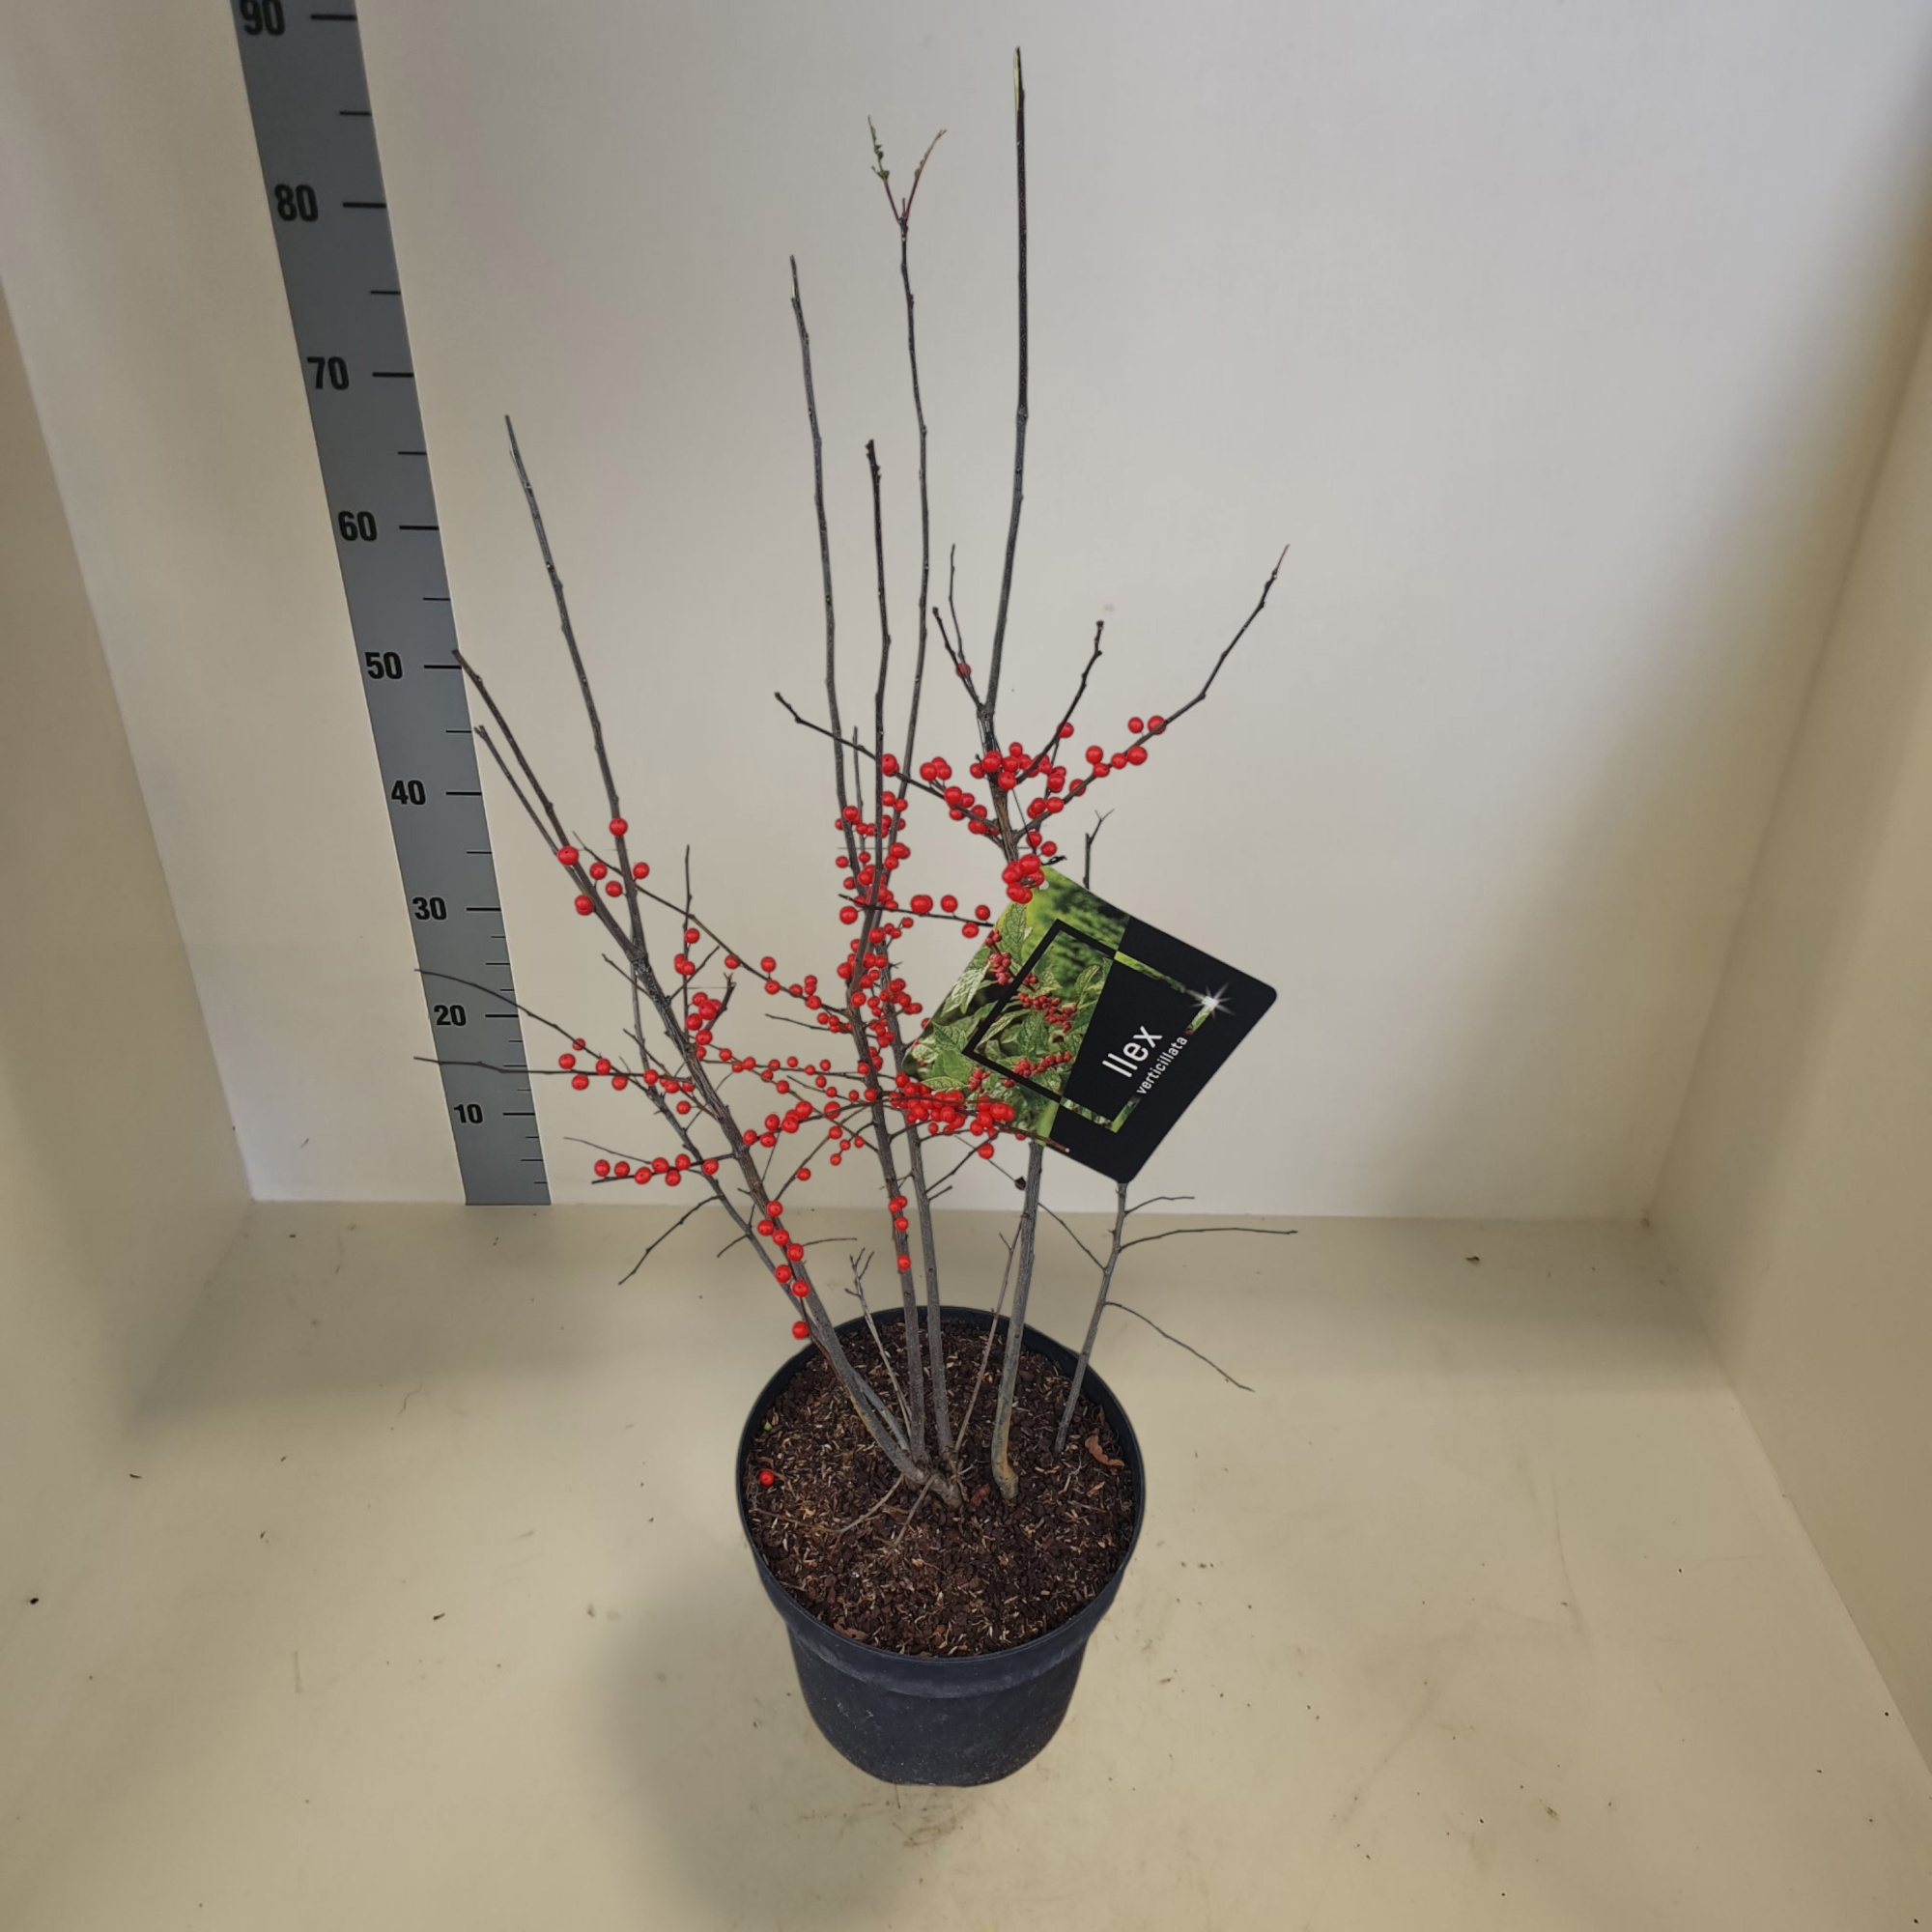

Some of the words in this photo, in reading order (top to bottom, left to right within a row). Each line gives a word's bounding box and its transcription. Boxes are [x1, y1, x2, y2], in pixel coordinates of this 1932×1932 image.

[240, 0, 285, 36] 90
[274, 184, 319, 221] 80
[306, 355, 350, 390] 70
[338, 510, 378, 541] 60
[365, 651, 403, 680] 50
[390, 780, 425, 806] 40
[412, 896, 446, 921] 30
[434, 1005, 467, 1027] 20
[1101, 1025, 1163, 1078] Ilex
[1136, 1036, 1188, 1094] verticillata
[453, 1103, 483, 1124] 10
